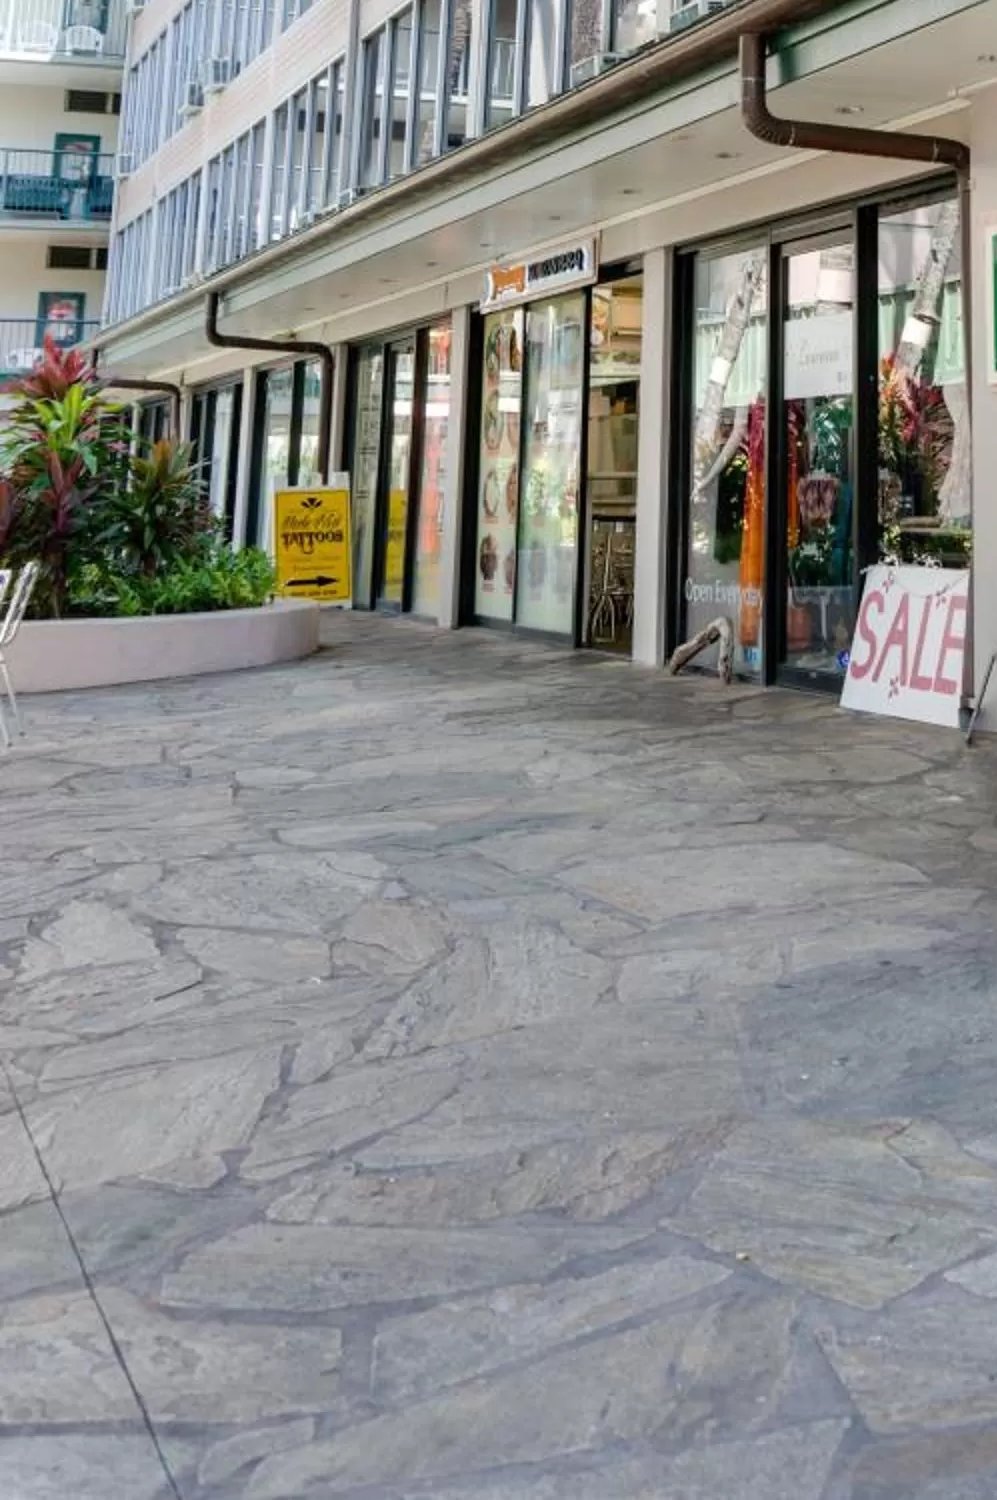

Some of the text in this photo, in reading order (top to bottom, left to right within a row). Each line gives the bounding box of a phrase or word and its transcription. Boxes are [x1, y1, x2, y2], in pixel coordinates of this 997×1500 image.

[281, 530, 343, 555] TATTOOS
[685, 577, 712, 605] Open
[851, 590, 968, 695] SALE
